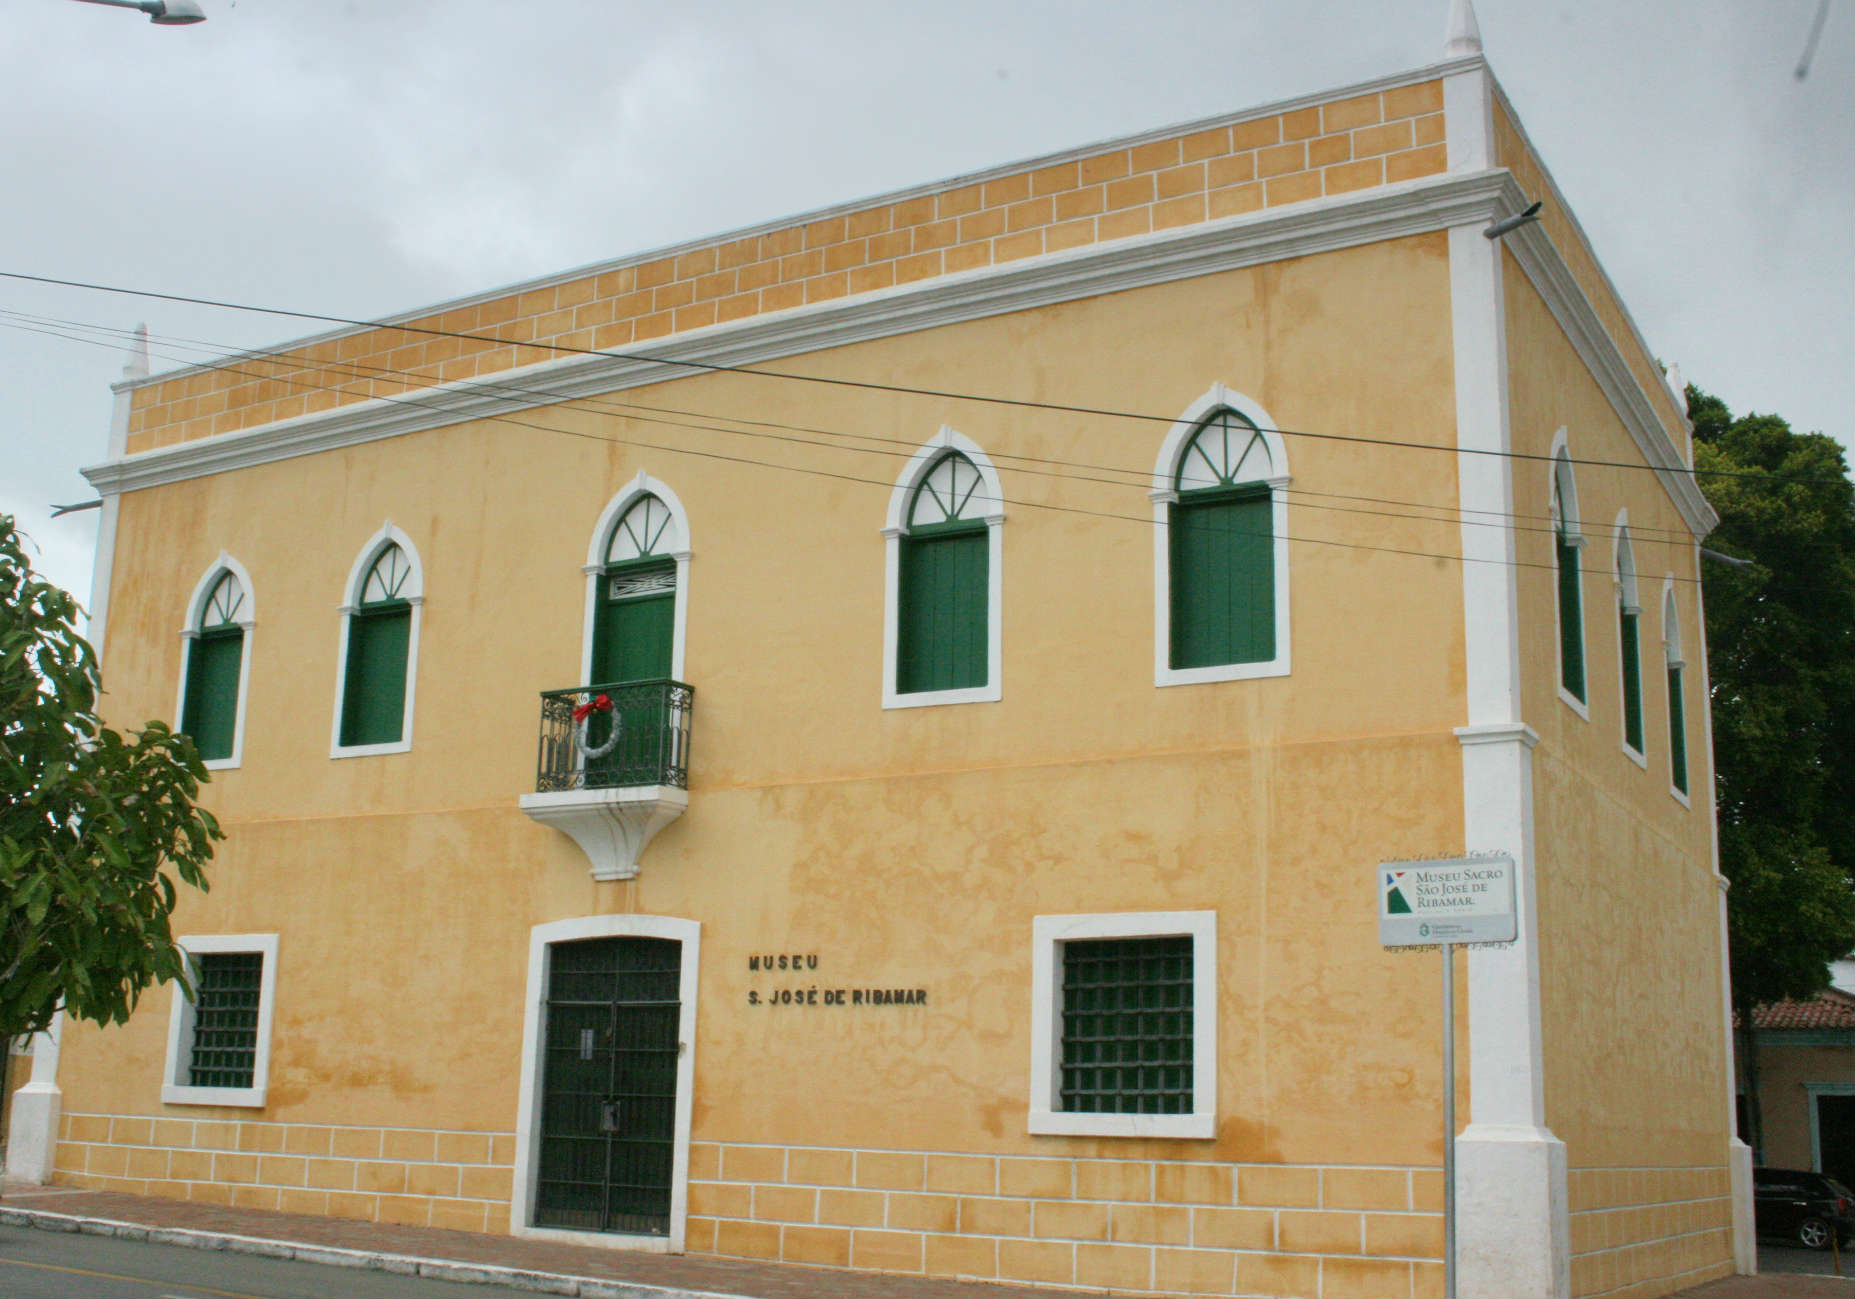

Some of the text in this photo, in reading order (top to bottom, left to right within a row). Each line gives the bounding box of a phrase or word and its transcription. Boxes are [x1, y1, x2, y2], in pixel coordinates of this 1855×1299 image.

[1416, 868, 1503, 883] MUSEU SACRO
[1416, 884, 1439, 896] SÃO
[1472, 883, 1488, 892] DE
[1417, 896, 1476, 908] RIBAMAR
[749, 954, 818, 970] MUSEU
[748, 985, 927, 1005] S. JOSÉ DE RIBAMAR
